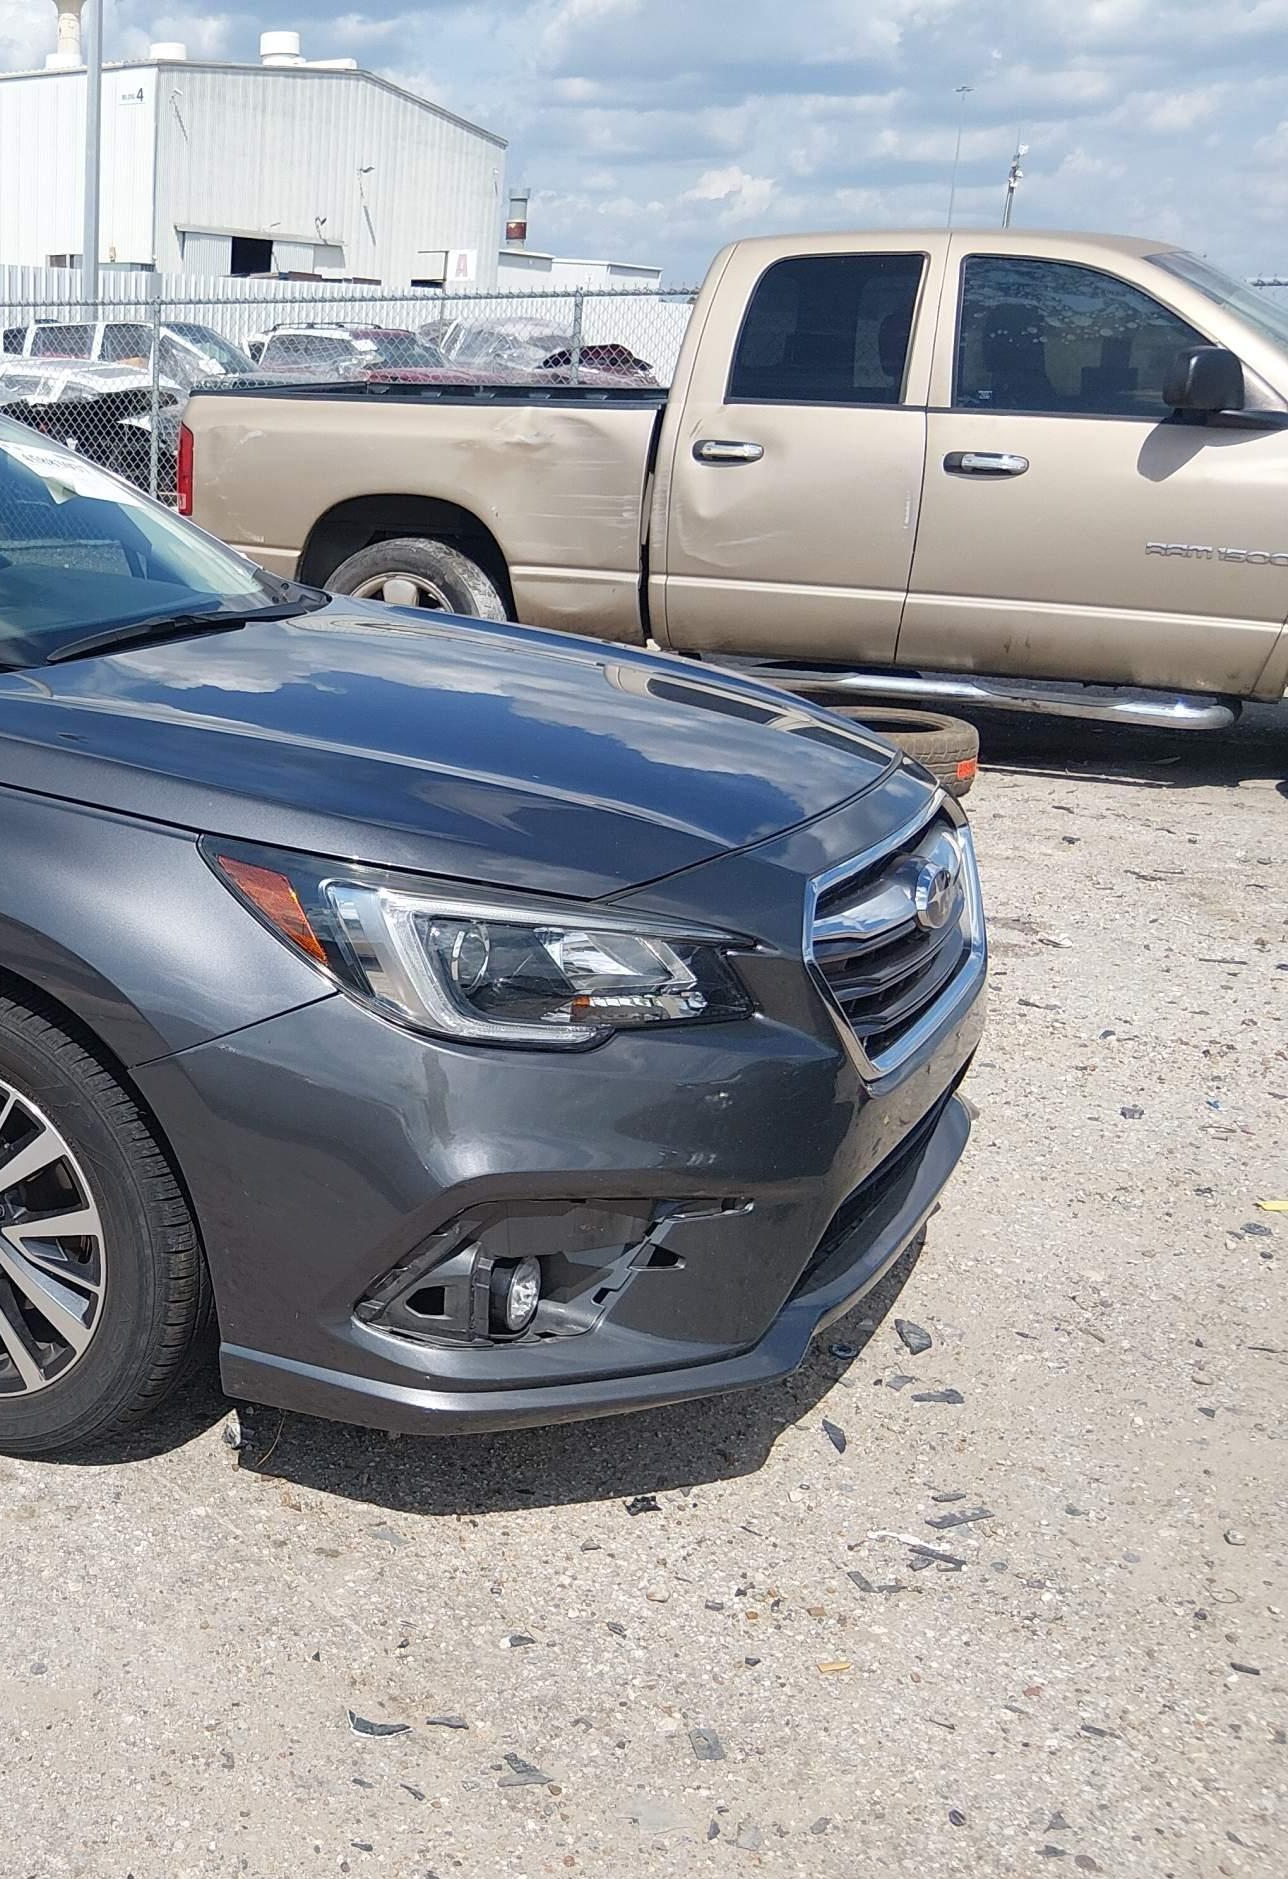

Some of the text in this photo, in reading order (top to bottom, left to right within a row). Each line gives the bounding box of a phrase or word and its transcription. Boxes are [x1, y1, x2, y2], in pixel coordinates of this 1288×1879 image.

[135, 87, 144, 102] 4
[455, 253, 468, 278] A
[1145, 541, 1213, 560] RAM
